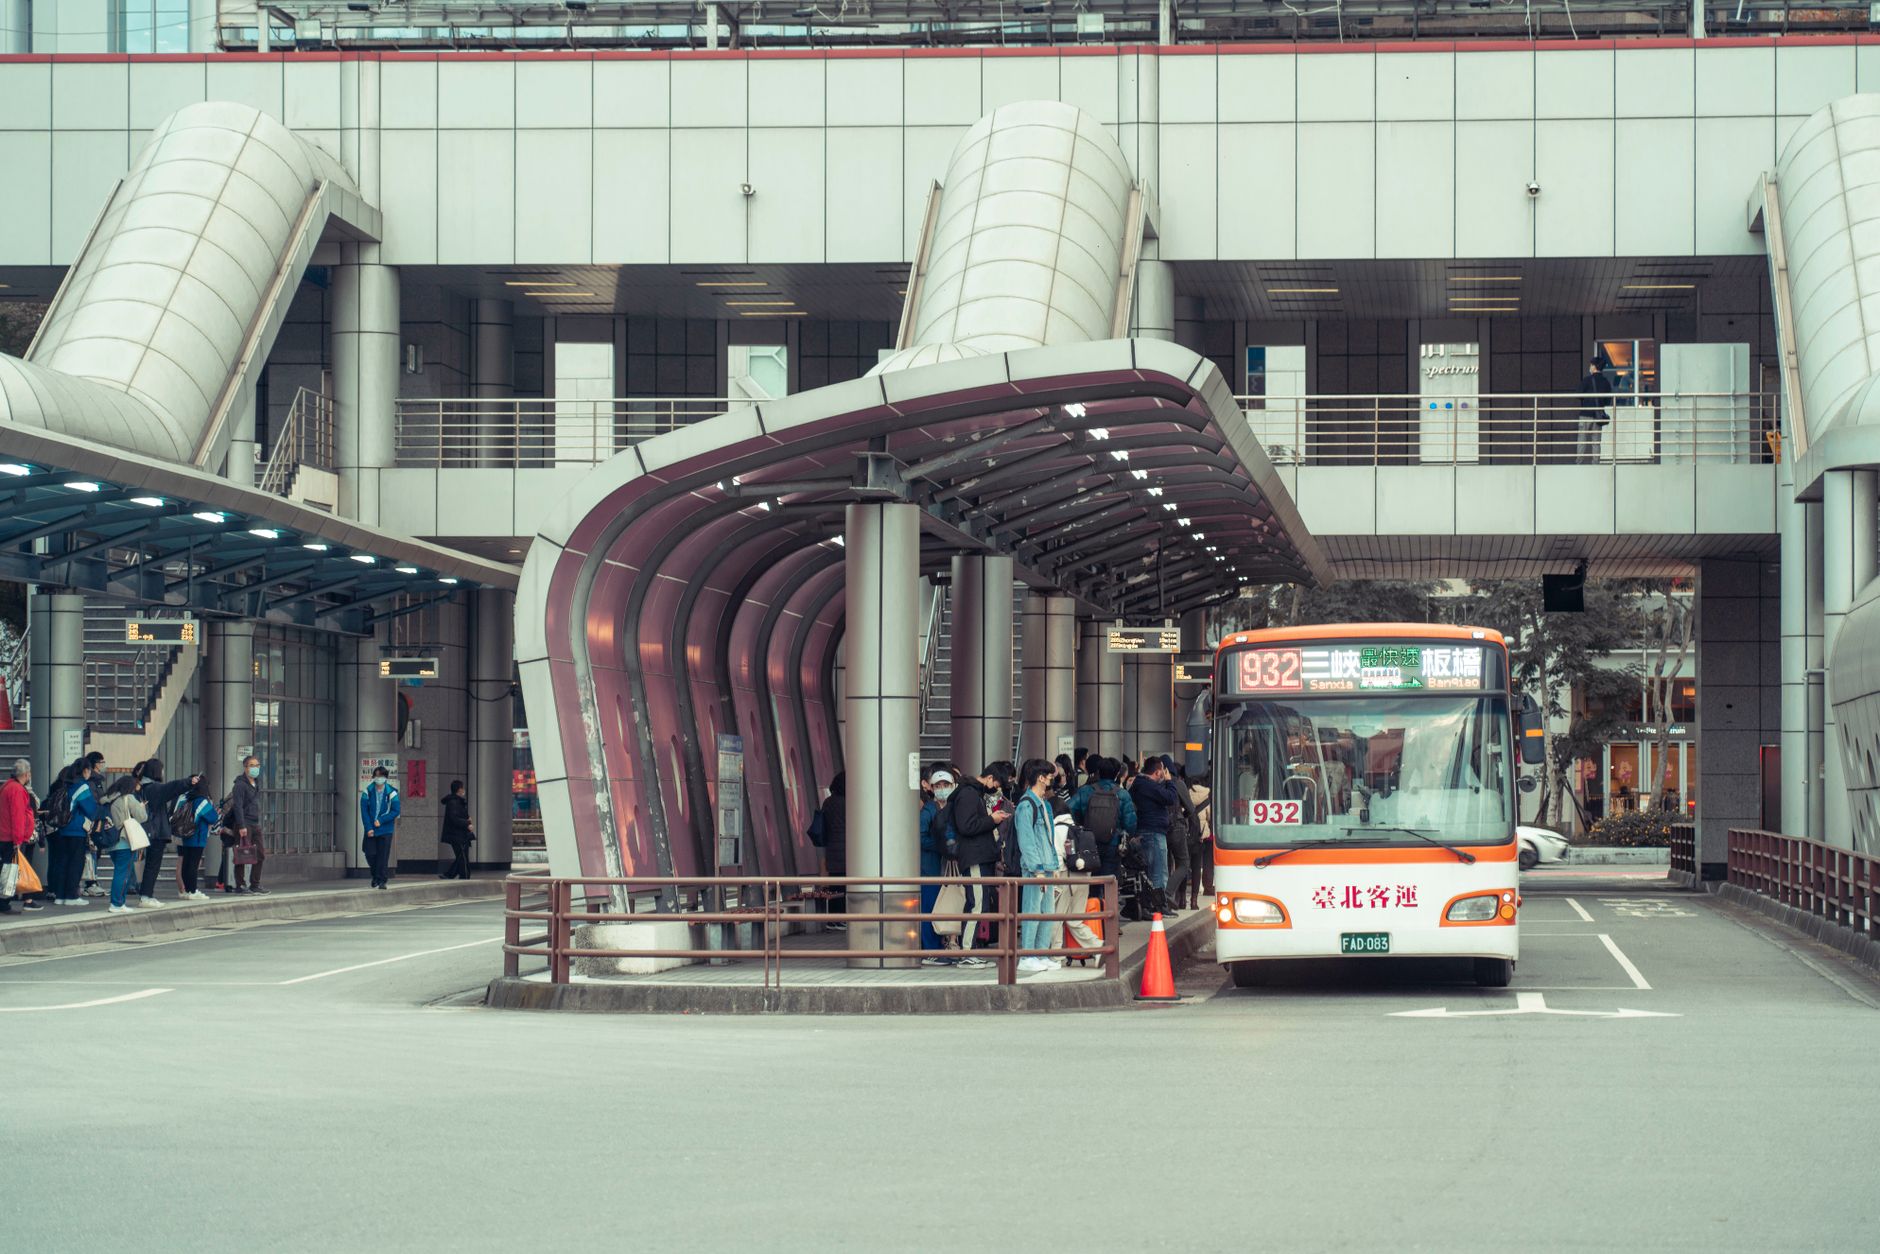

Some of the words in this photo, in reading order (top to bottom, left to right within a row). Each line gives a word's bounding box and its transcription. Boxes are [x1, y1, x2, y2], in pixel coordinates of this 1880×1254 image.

[1243, 652, 1300, 687] 932
[1301, 649, 1361, 679] 三峽
[1421, 647, 1482, 677] 板橋
[1309, 679, 1354, 690] Sanxia
[1428, 677, 1480, 688] Banqiao
[1253, 802, 1299, 824] 932
[1312, 885, 1418, 909] 臺北客運
